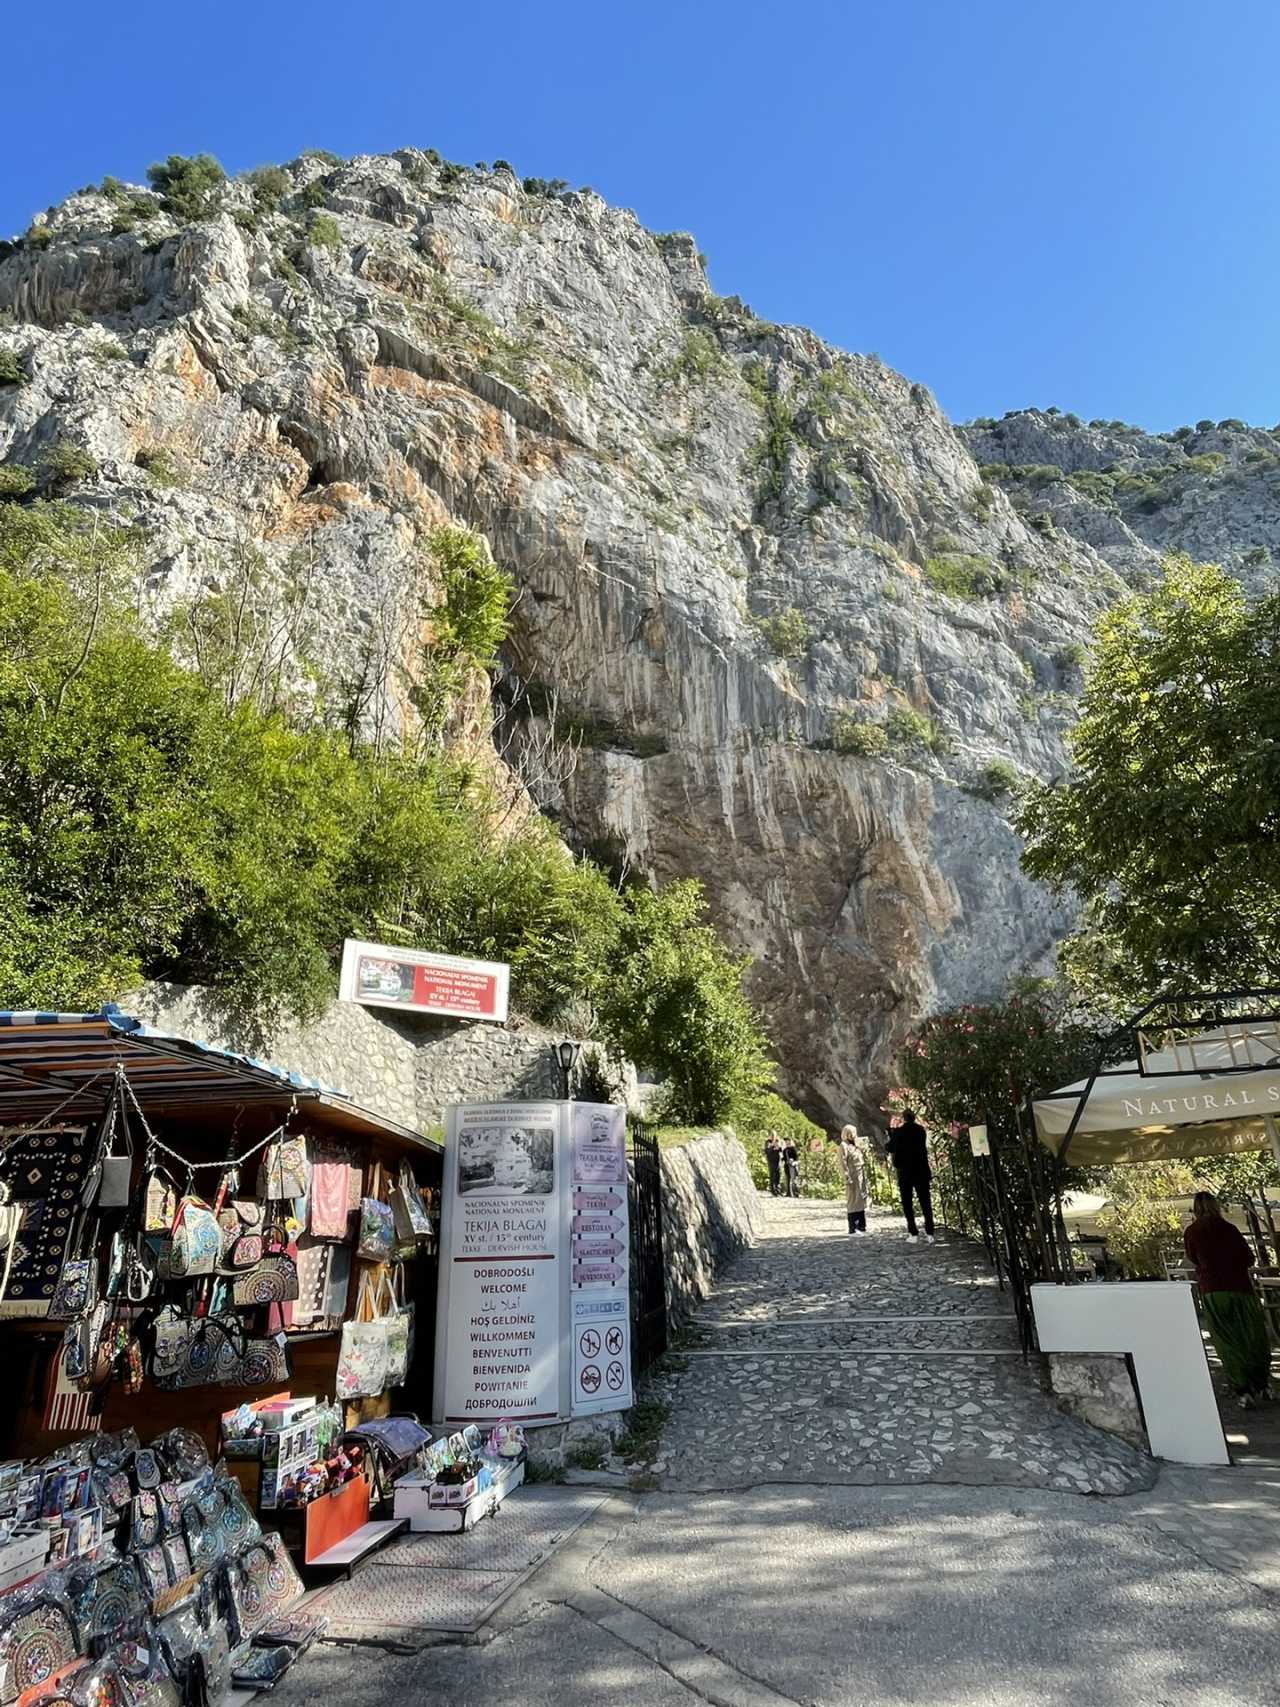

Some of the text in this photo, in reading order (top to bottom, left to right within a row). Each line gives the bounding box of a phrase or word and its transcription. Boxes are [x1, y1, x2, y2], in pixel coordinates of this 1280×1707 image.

[1122, 1090, 1255, 1117] NATURAL
[464, 1219, 546, 1232] TEKIJA BLAGAJ
[464, 1235, 476, 1243] XV
[513, 1234, 545, 1243] century
[480, 1283, 527, 1294] WELCOME
[470, 1316, 490, 1328] HOŞ
[470, 1331, 535, 1342] WILLKOMMEN
[472, 1347, 532, 1358] BENVENUTTI
[473, 1364, 530, 1375] BIENVENIDA
[475, 1381, 529, 1391] POWITANIE
[465, 1397, 537, 1410] ДОБРОДОШЛИ
